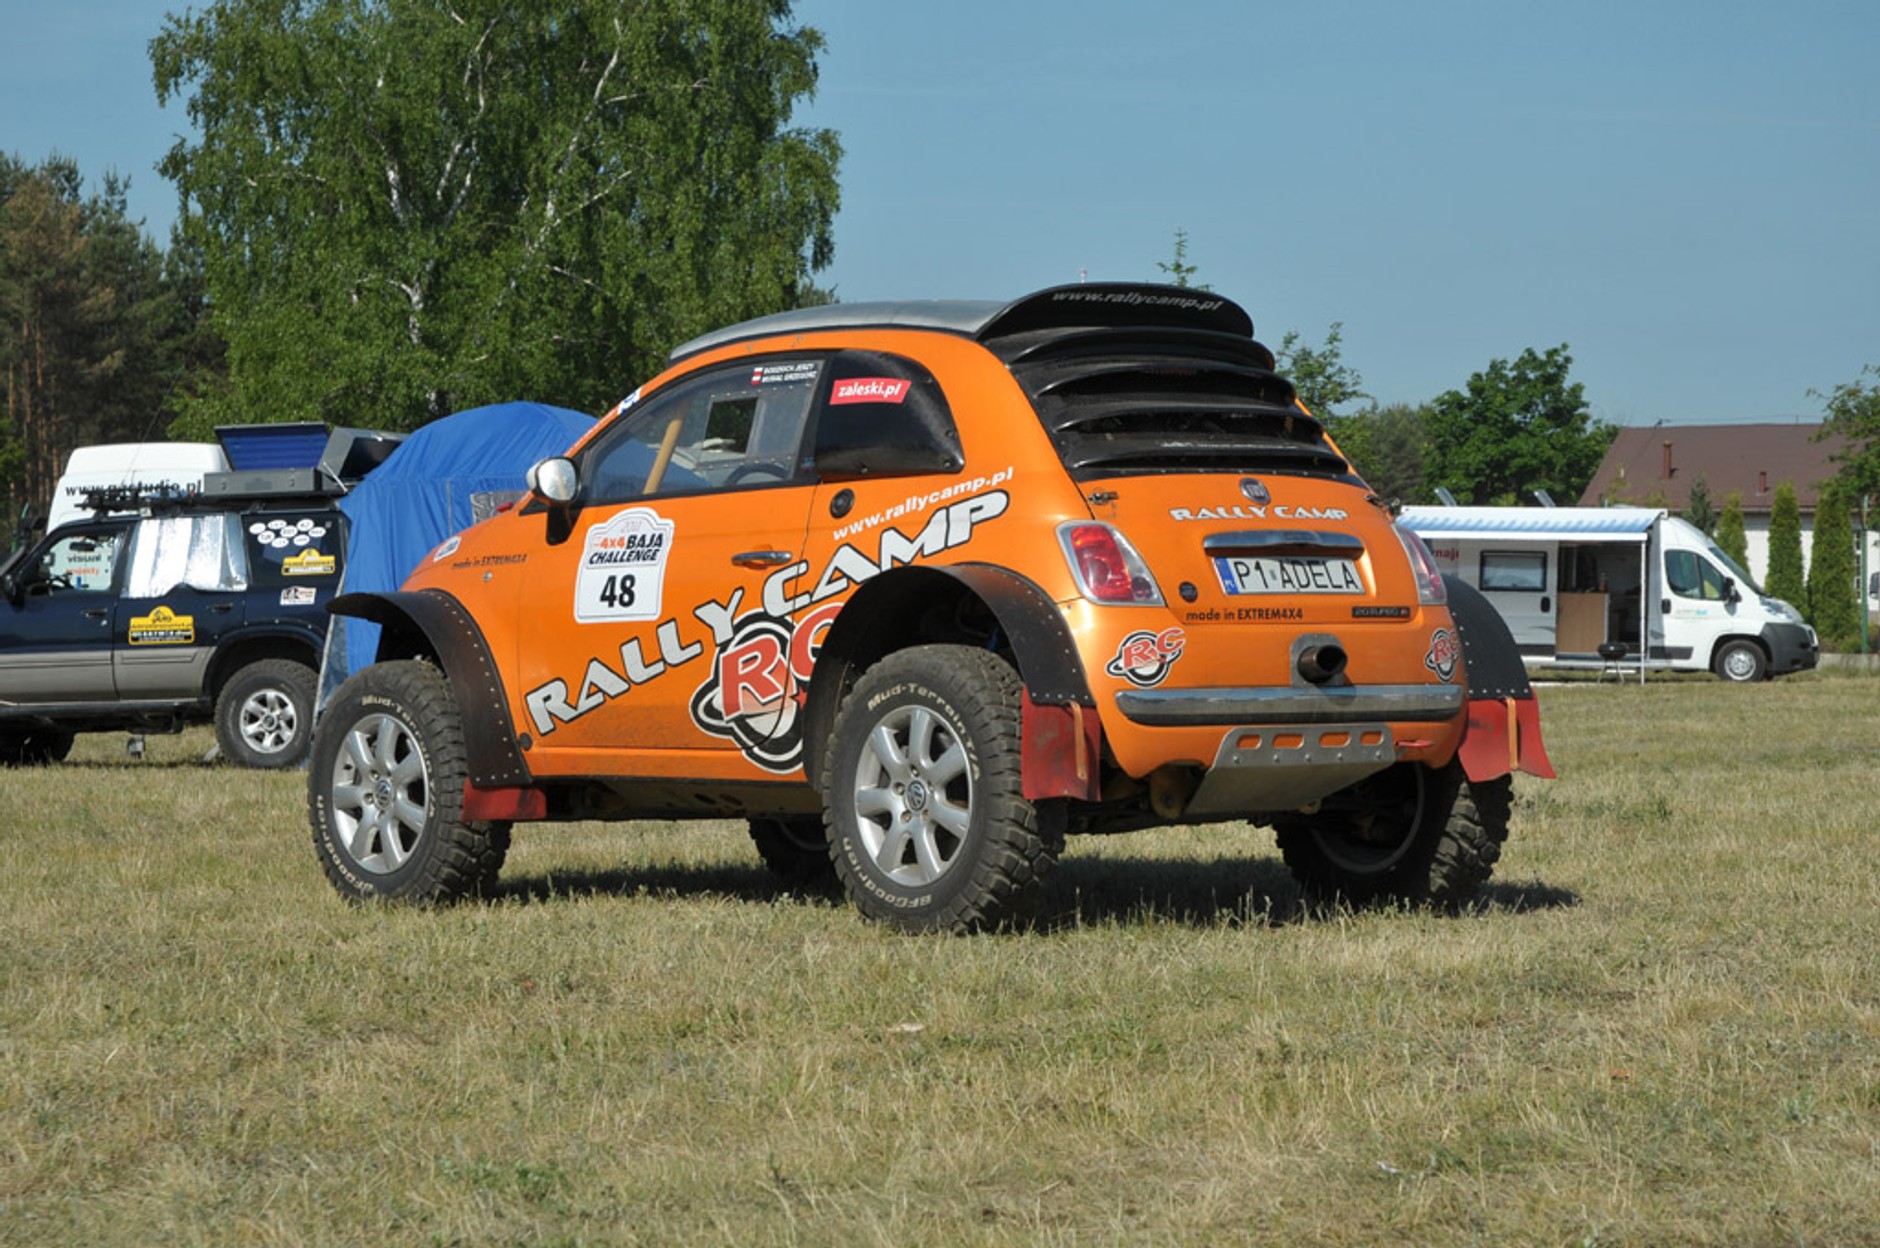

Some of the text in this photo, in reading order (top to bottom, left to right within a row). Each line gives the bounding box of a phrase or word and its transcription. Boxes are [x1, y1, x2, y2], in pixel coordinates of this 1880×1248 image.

[1052, 291, 1225, 311] www.rallycamp.pl
[837, 381, 902, 399] zaleski.pl
[833, 466, 1014, 541] www.rallycamp.pl
[1169, 505, 1349, 521] RALLY CAMP
[588, 549, 661, 565] CHALLENGE
[626, 533, 664, 550] BAJA
[1233, 560, 1360, 589] P1 ADELA
[600, 574, 637, 608] 48
[525, 489, 1010, 737] RALLY CAMP
[1186, 607, 1304, 621] made in EXTREM4X4
[719, 602, 846, 723] RC
[1122, 627, 1186, 670] RC
[867, 682, 967, 737] Mud-Terrain
[842, 836, 933, 909] BFGoodrich
